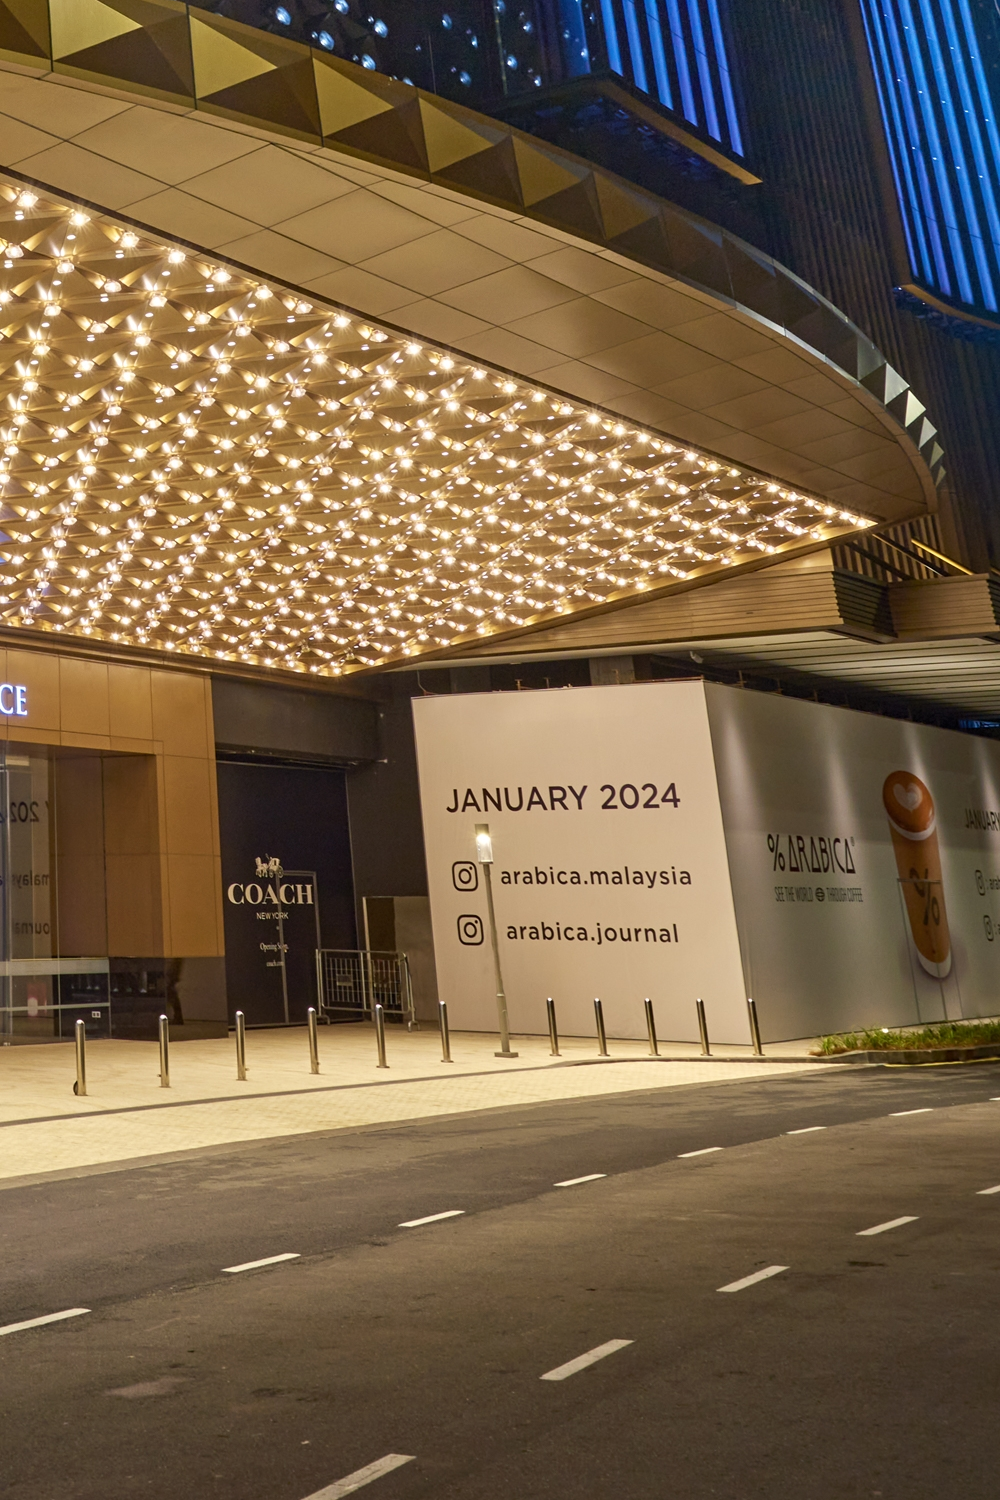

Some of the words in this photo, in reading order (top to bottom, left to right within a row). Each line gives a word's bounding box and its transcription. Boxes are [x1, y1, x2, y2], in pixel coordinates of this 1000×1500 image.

[446, 785, 588, 813] JANUARY
[600, 783, 681, 810] 2024
[501, 866, 692, 889] arabica.malaysia
[227, 883, 314, 905] COACH
[256, 912, 270, 920] NEW
[271, 912, 288, 920] YORK
[506, 922, 679, 945] arabica.journal
